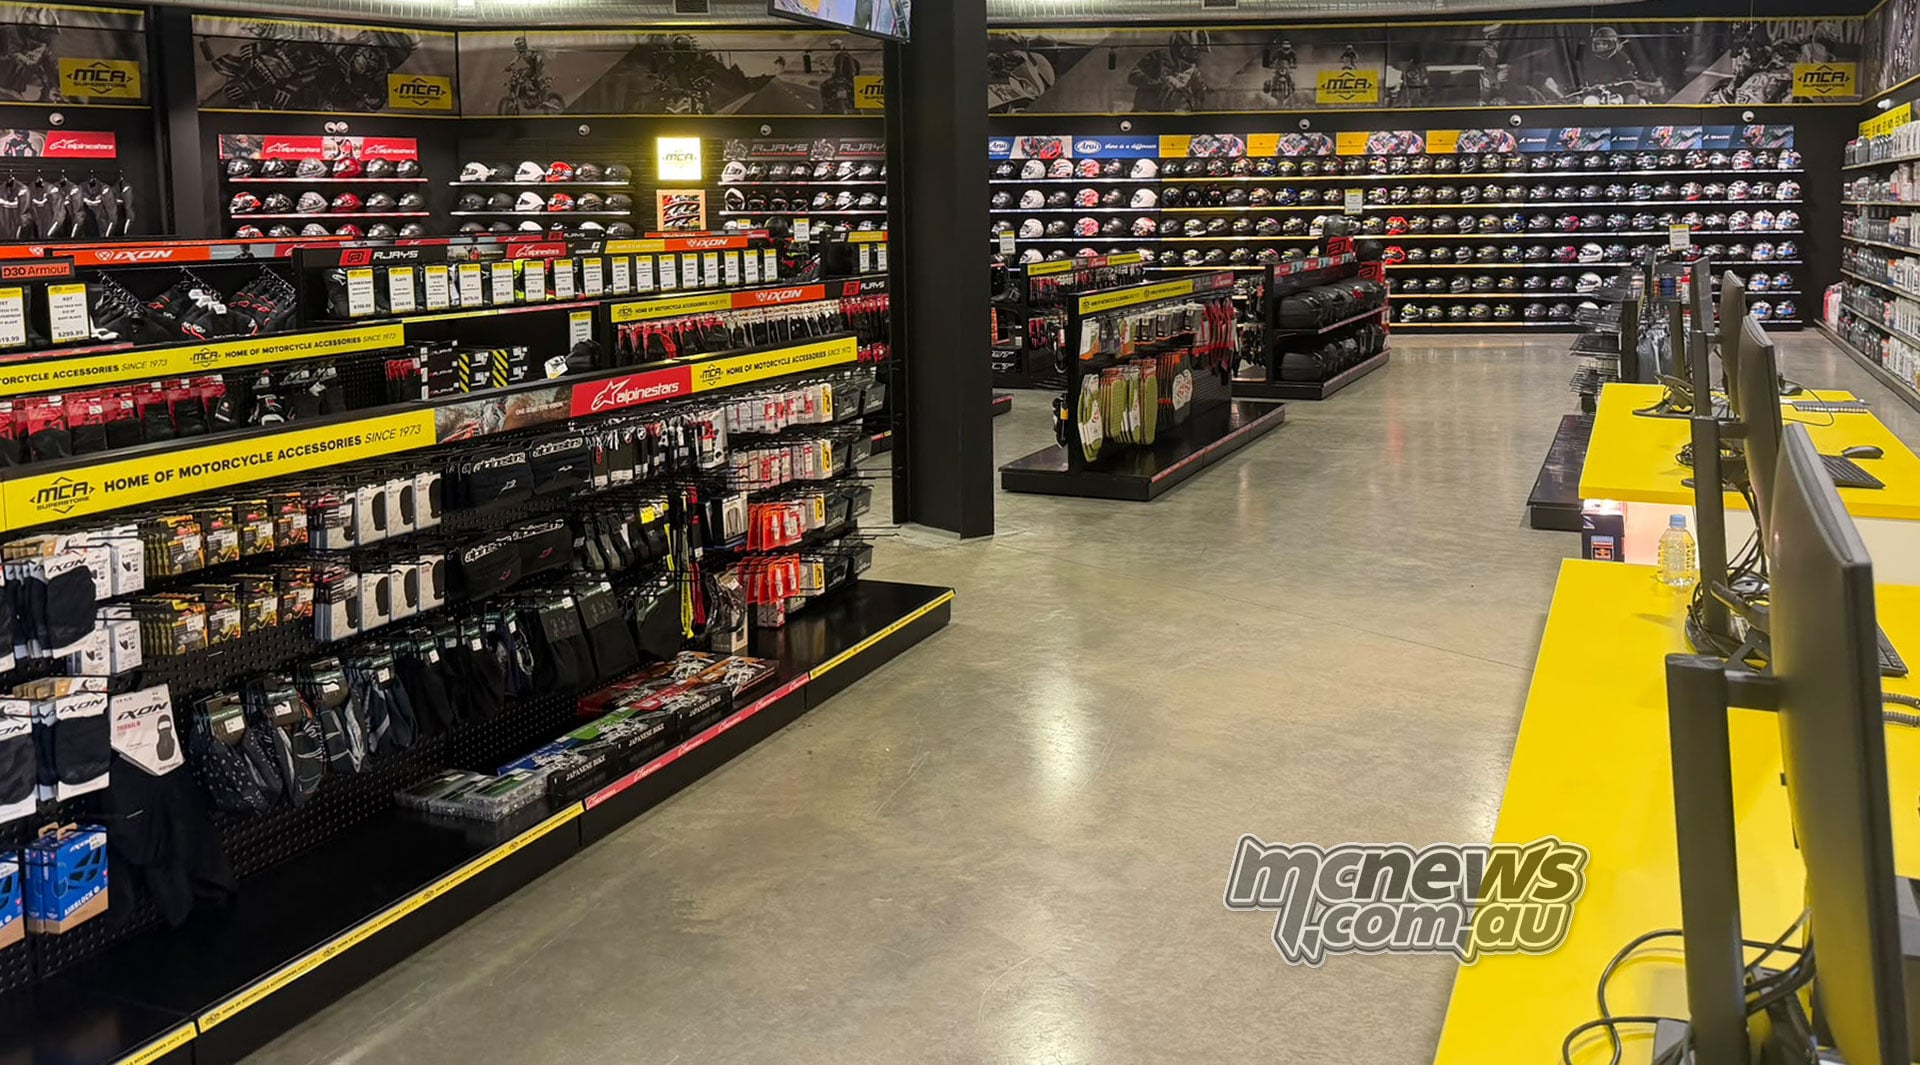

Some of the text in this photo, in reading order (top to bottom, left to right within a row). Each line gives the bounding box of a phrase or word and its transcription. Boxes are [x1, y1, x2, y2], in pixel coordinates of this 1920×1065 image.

[73, 68, 126, 82] MCA
[1803, 72, 1845, 82] MCA
[399, 83, 441, 95] MCA
[1326, 78, 1368, 89] MCA
[839, 143, 886, 151] RJAY
[665, 152, 694, 161] MCA
[696, 239, 729, 247] IXON
[114, 250, 173, 261] IXON
[373, 250, 419, 260] RJAYS
[28, 266, 67, 275] Armour
[767, 289, 802, 301] IXON
[225, 350, 247, 358] HOME
[262, 341, 312, 354] MOTORCYCLE
[314, 337, 361, 348] ACCESSORIES
[362, 334, 381, 343] SINCE
[193, 351, 218, 360] MCA
[726, 365, 743, 375] HOME
[744, 364, 752, 372] OF
[754, 357, 791, 369] MOTORCYCLE
[792, 351, 826, 363] ACCESSORIES
[0, 359, 168, 385] ORCYCLE ACCESSORIES SINCE 1973
[702, 367, 721, 379] MCA
[616, 382, 680, 404] alpinestars
[104, 424, 421, 492] HOME OF MOTORCYCLE ACCESSORIES SINCE 1973
[37, 481, 88, 504] MCA
[37, 496, 89, 510] SUPERSTORE
[48, 557, 87, 574] IXON
[59, 697, 105, 714] IXON
[116, 701, 168, 721] IXON
